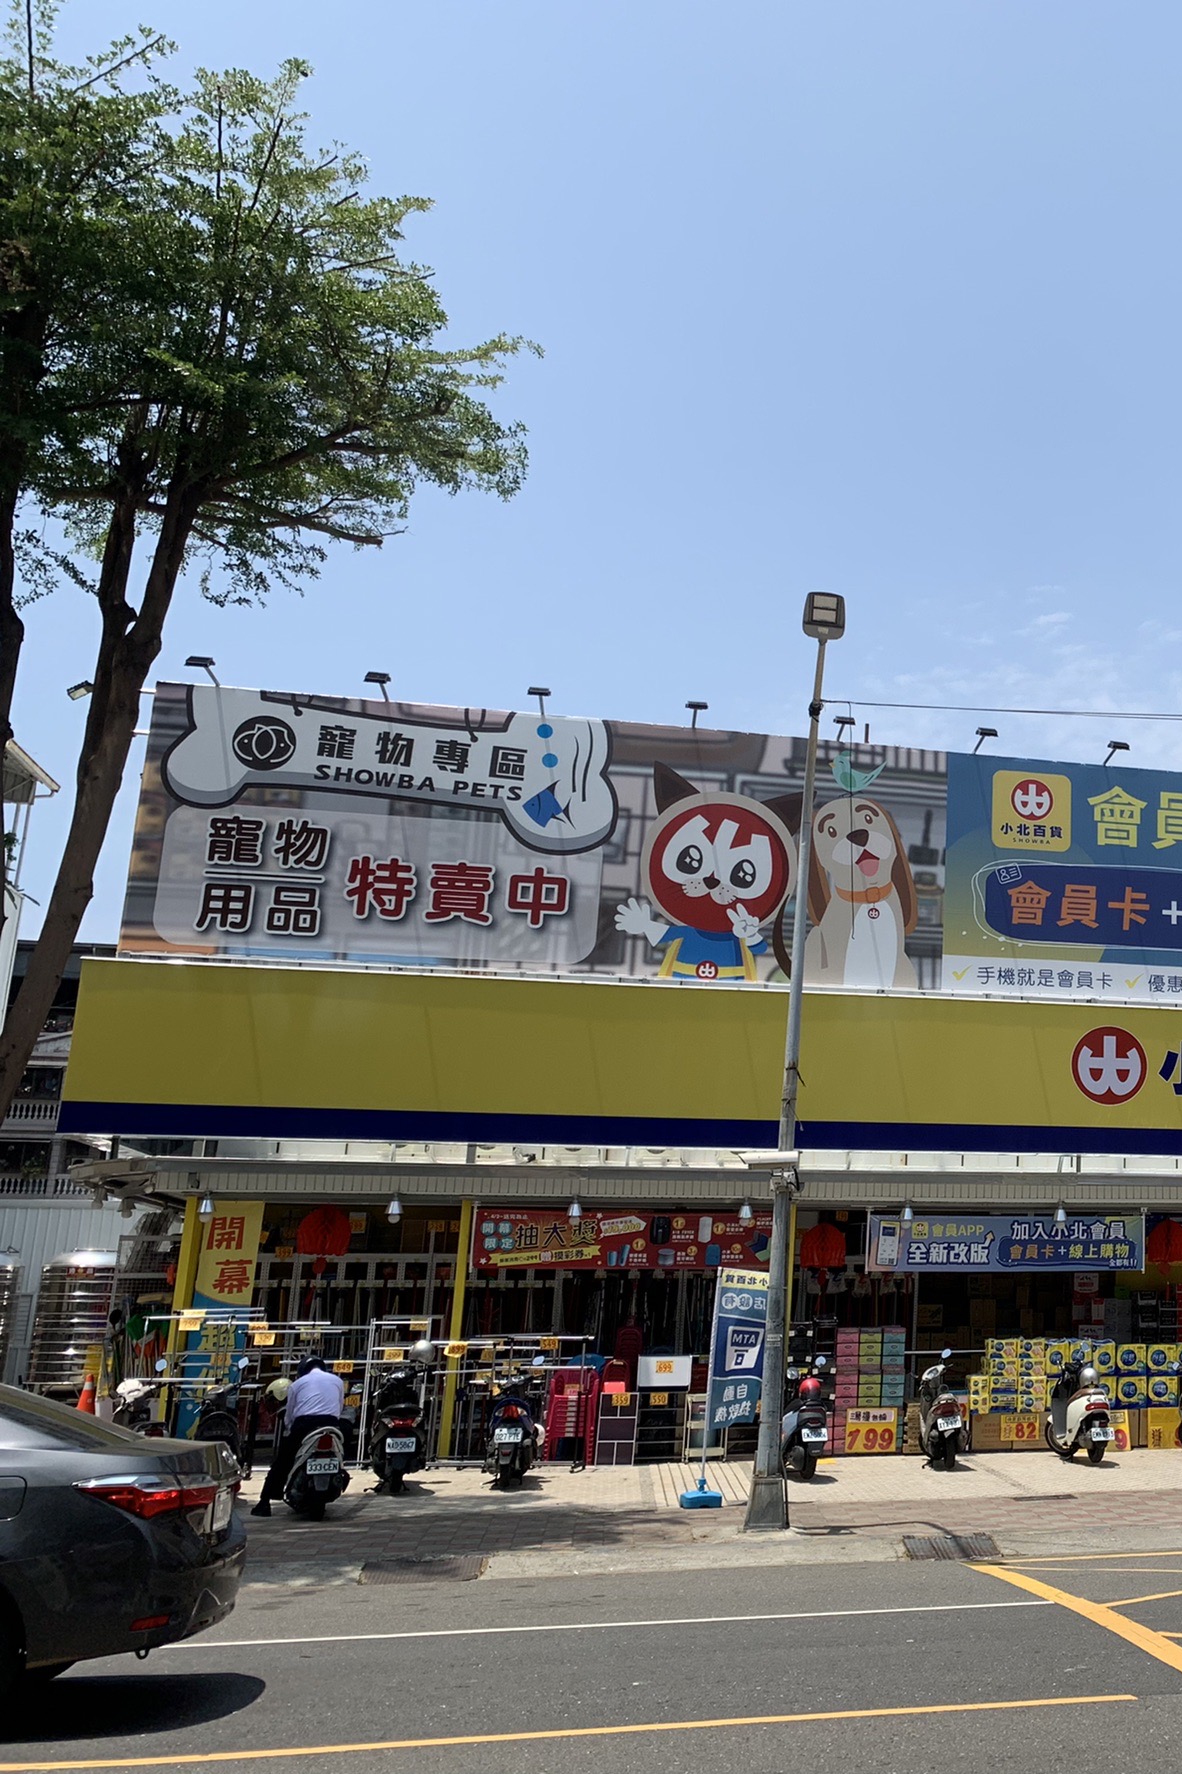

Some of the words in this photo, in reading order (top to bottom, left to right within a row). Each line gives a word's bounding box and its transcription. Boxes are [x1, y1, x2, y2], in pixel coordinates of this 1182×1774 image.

[317, 724, 529, 782] 寵物專區
[313, 764, 436, 793] SHOWBA
[451, 780, 523, 802] PETS
[1000, 822, 1062, 839] 小北百貨
[207, 816, 331, 869] 寵物
[346, 855, 571, 928] 特賣中
[196, 881, 320, 936] 用品
[977, 965, 1113, 989] 手機就是會員卡
[515, 1219, 598, 1250] 抽大獎
[931, 1223, 985, 1237] 會員APP
[1012, 1221, 1126, 1241] 加入小北會員
[205, 1215, 253, 1295] 開幕
[908, 1242, 990, 1265] 全新改版
[657, 1363, 672, 1373] 699
[614, 1394, 629, 1405] 359
[651, 1394, 666, 1404] 550
[1014, 1421, 1037, 1439] 82
